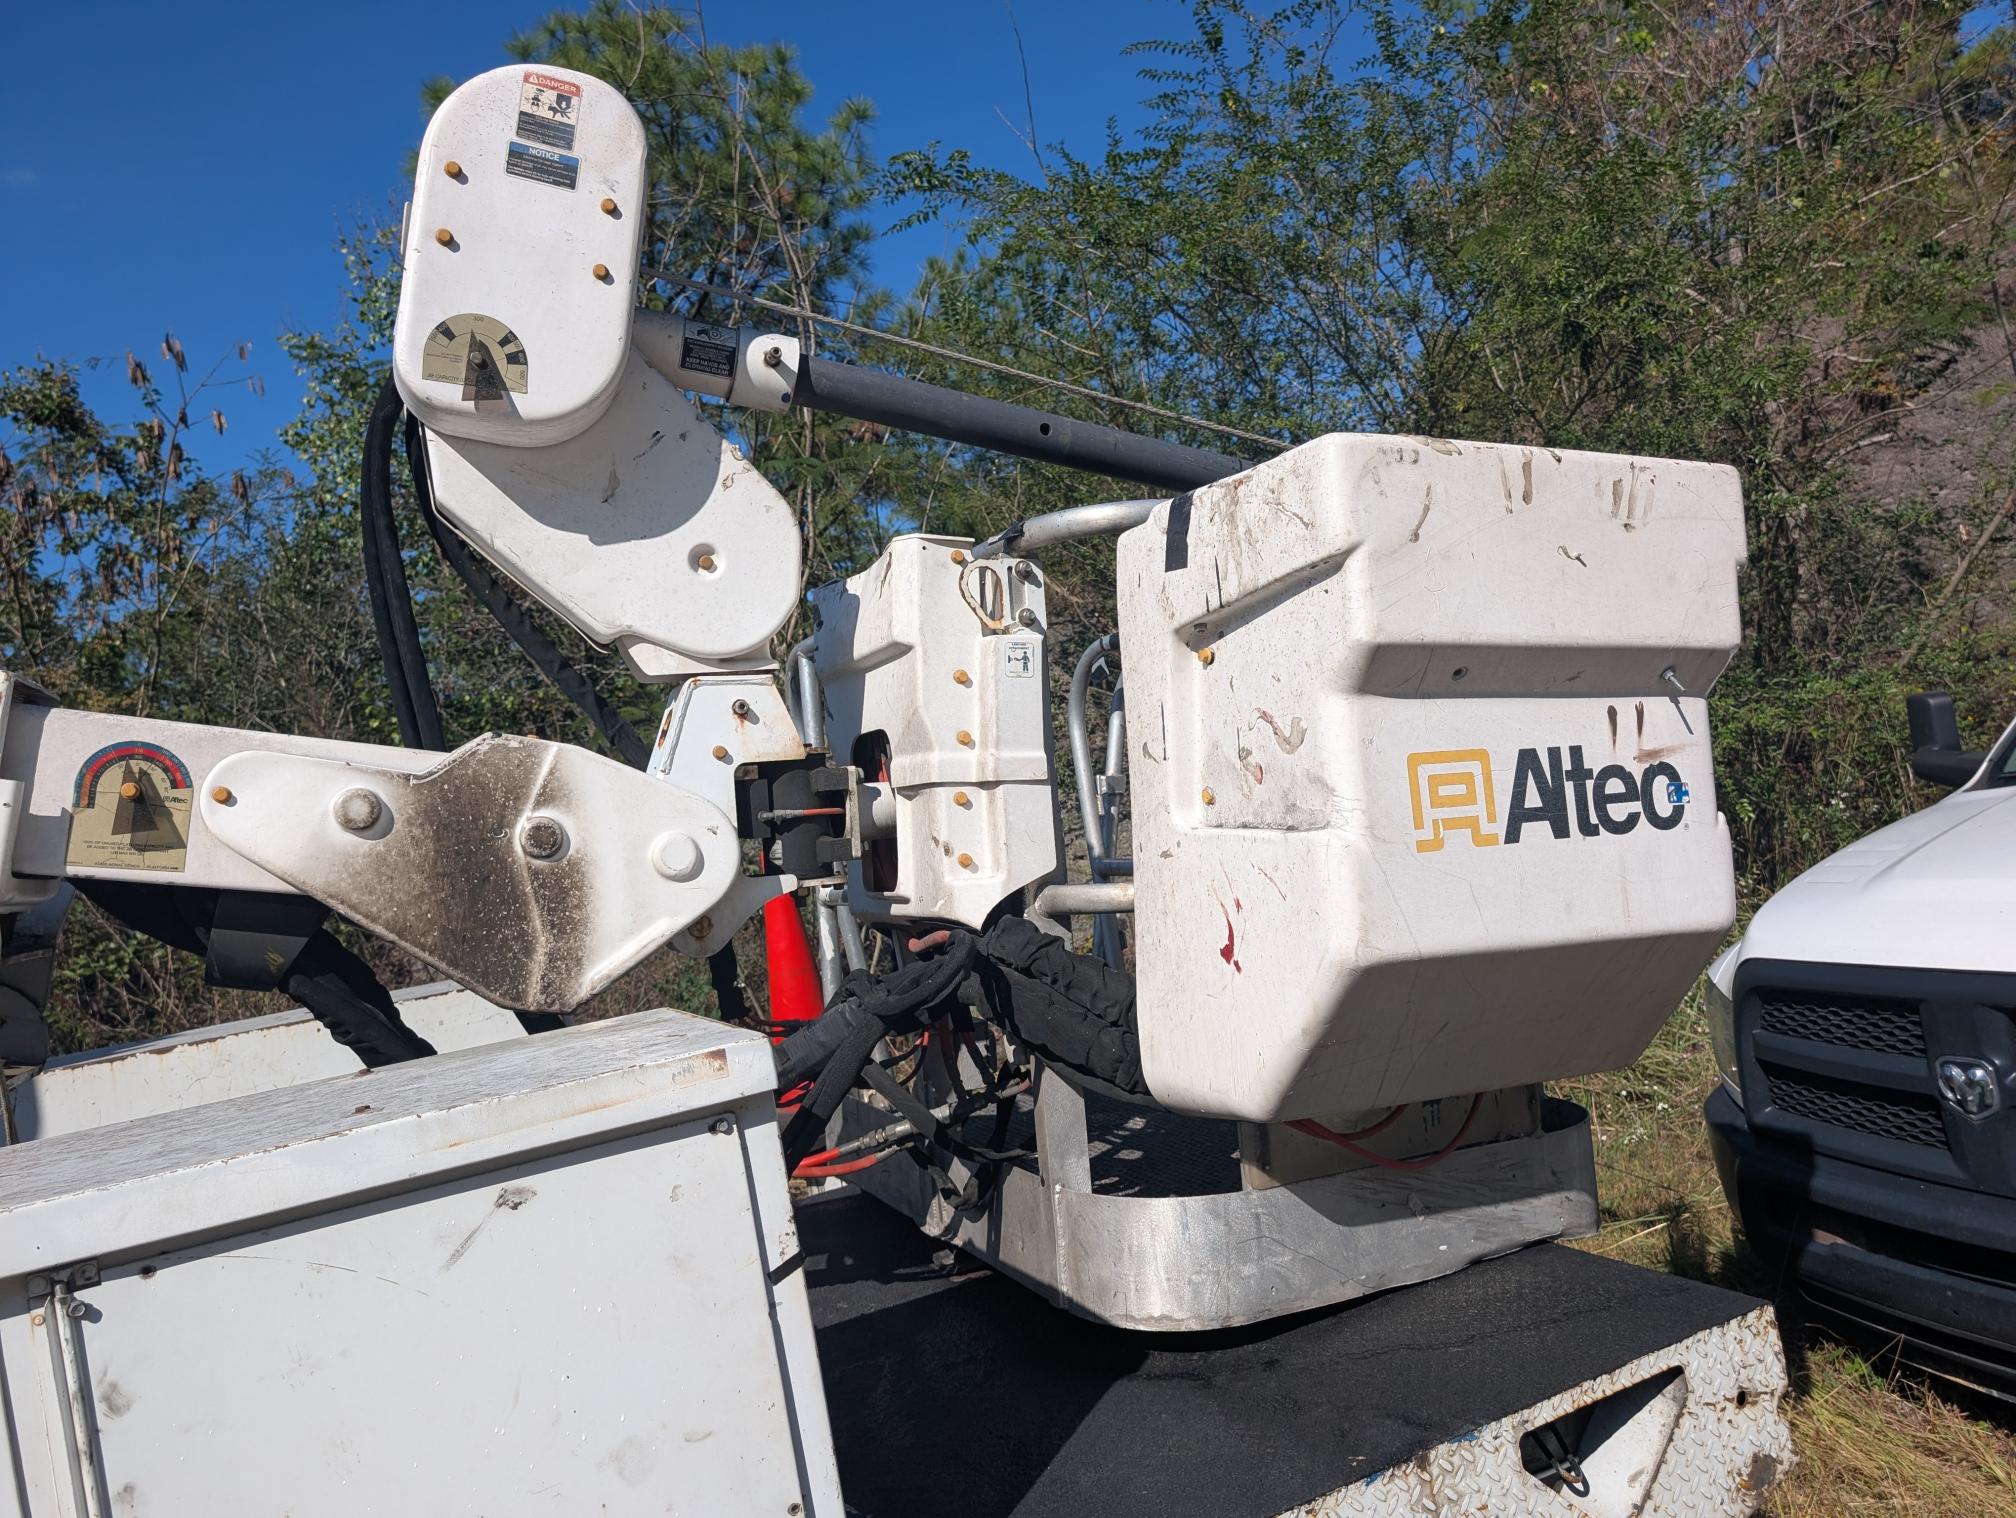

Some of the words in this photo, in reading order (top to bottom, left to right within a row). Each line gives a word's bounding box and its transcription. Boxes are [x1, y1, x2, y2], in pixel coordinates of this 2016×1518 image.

[538, 76, 577, 93] DANGER
[529, 147, 560, 161] NOTICE
[1504, 745, 1685, 844] Altec
